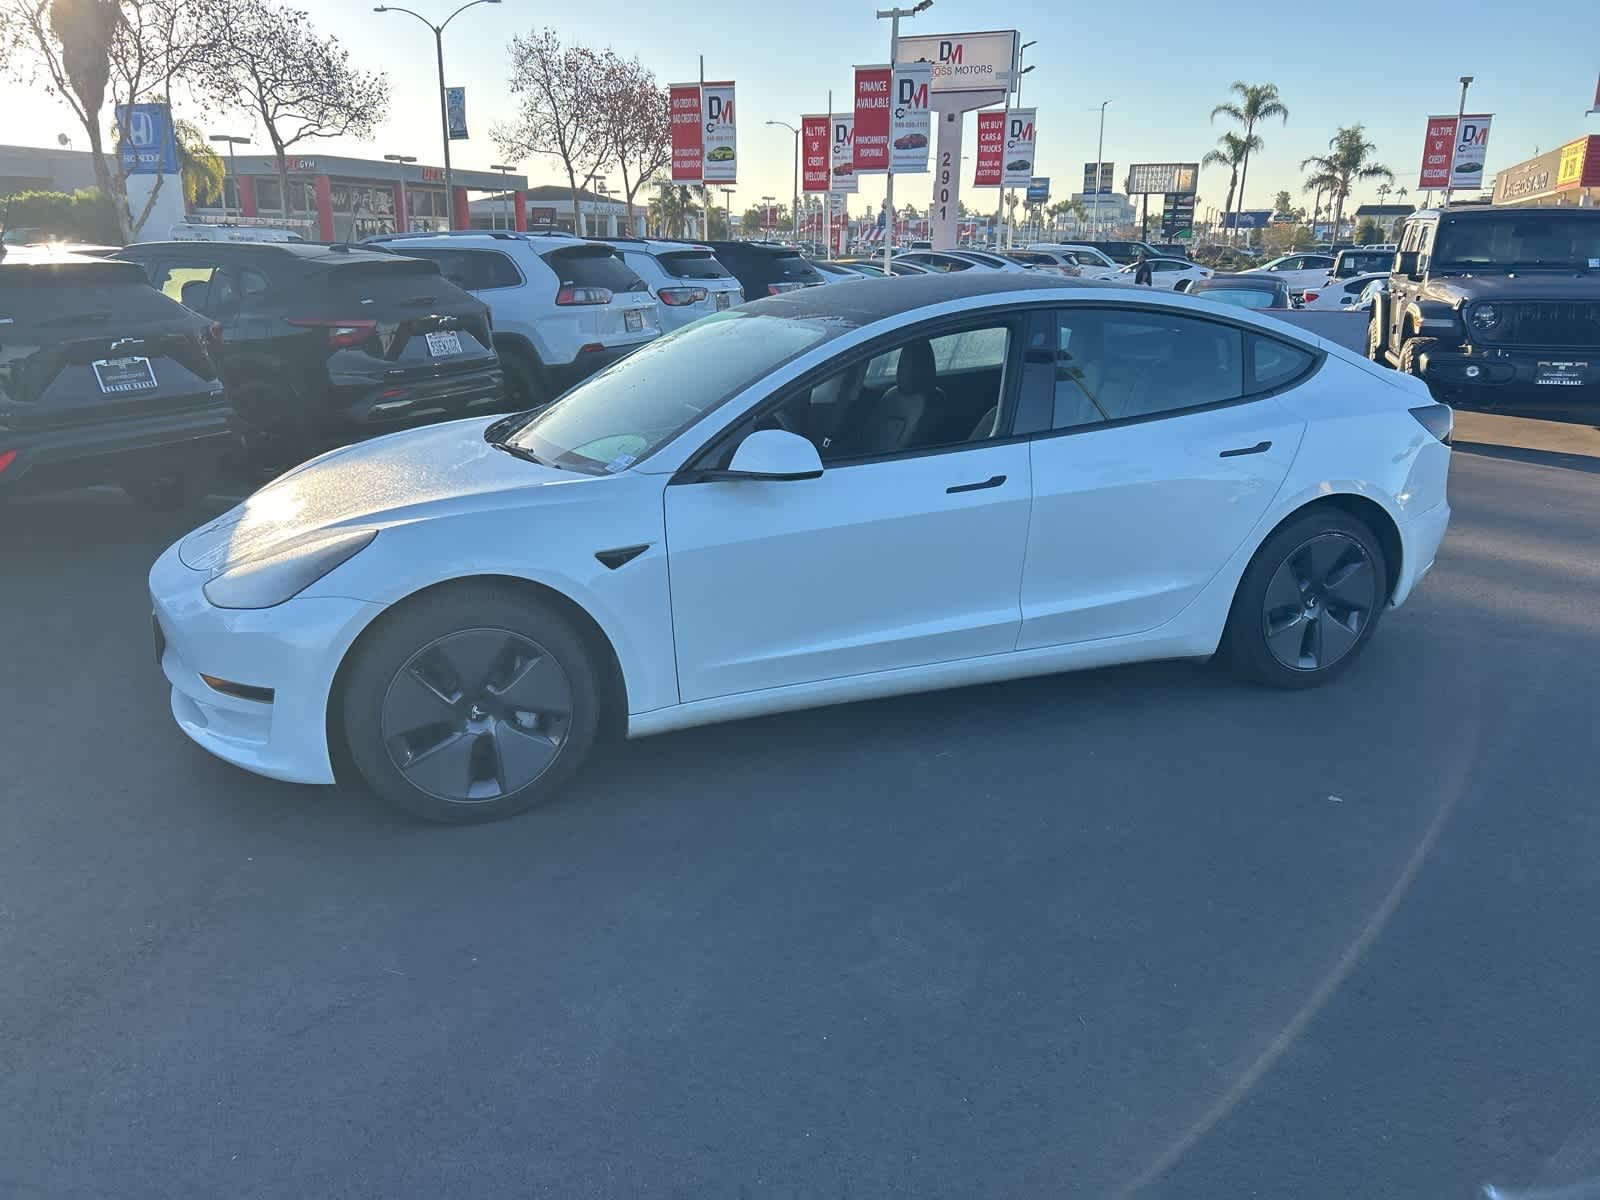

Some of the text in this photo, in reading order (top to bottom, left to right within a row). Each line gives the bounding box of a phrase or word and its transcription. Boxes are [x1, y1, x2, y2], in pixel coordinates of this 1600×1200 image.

[940, 41, 963, 64] DM
[955, 64, 993, 75] MOTORS
[860, 81, 887, 92] FINANCE
[899, 78, 929, 109] DM
[856, 97, 889, 108] AVAILABLE
[708, 96, 733, 124] DM
[981, 120, 1003, 129] WE BUY
[805, 126, 826, 136] ALL TYPE
[1010, 119, 1033, 141] DM
[1430, 126, 1453, 136] ALL TYPE
[1463, 125, 1488, 145] DM
[981, 133, 996, 141] CARS
[812, 141, 820, 151] OF
[980, 144, 1002, 152] TRUCKS
[1435, 141, 1444, 150] OF
[299, 159, 315, 169] GYM
[808, 156, 824, 166] CREDIT
[1428, 154, 1447, 164] CREDIT
[805, 171, 827, 181] WELCOME
[1423, 168, 1449, 178] WELCOME
[940, 152, 951, 220] 2901
